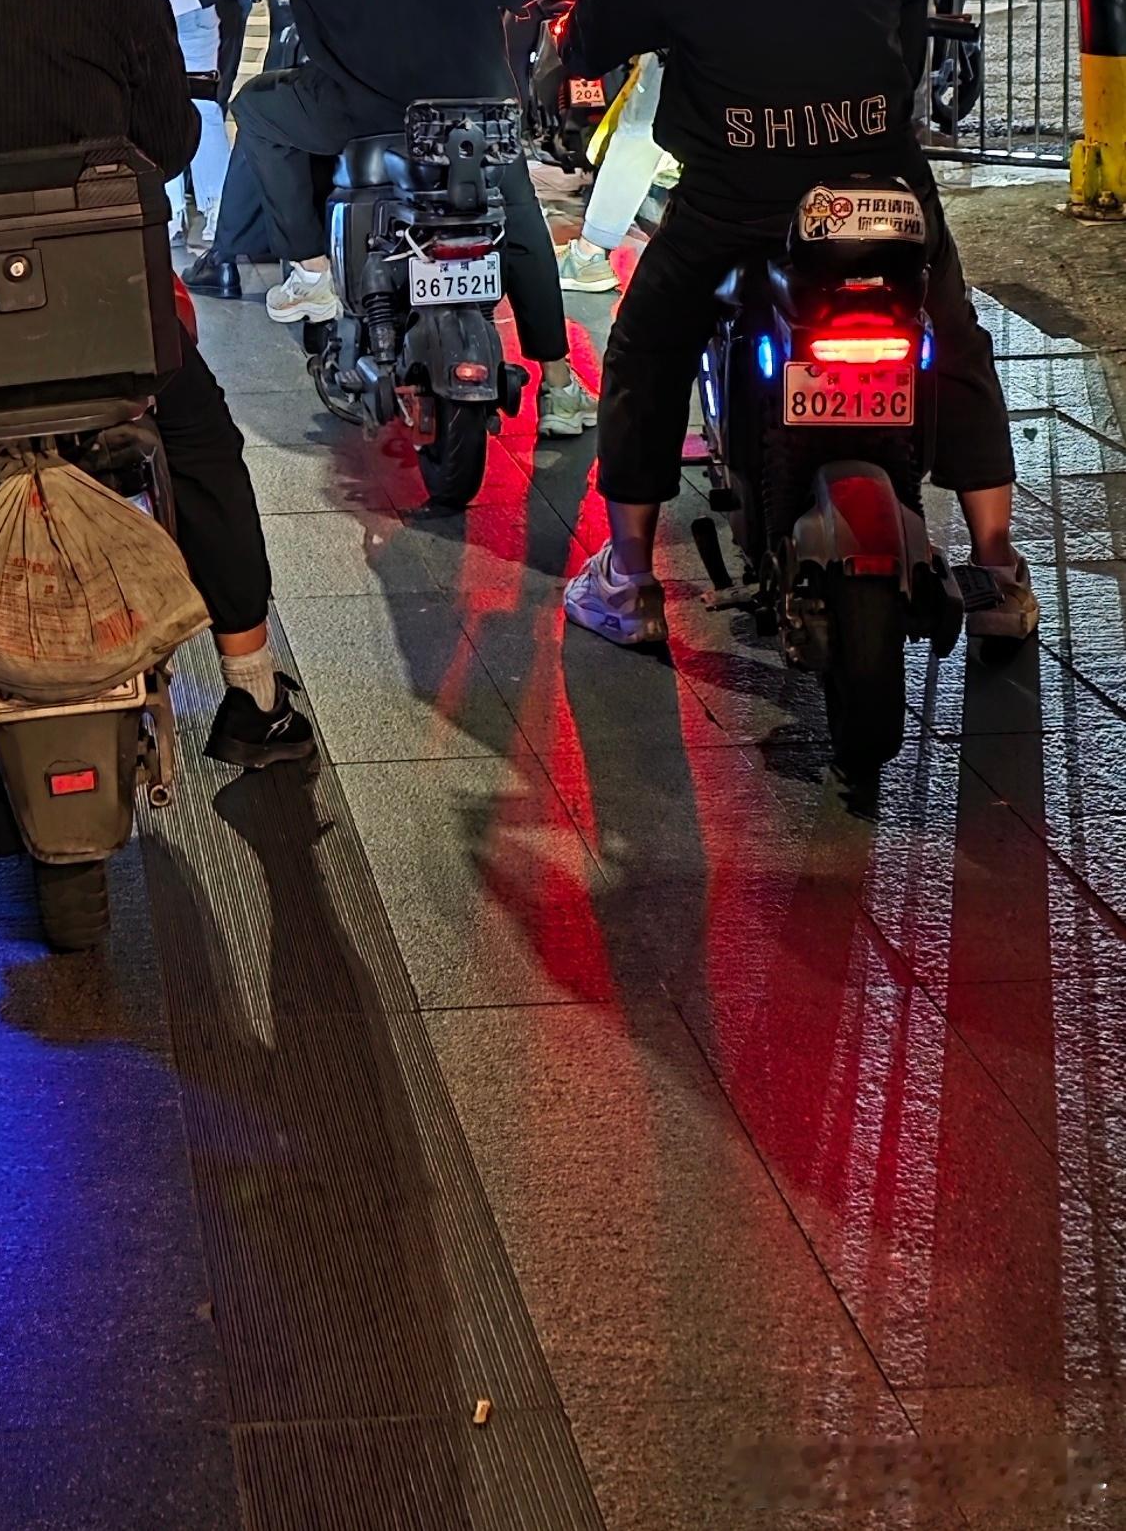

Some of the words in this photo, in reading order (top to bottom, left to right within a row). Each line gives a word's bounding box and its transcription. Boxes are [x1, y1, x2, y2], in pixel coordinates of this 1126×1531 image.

[575, 89, 601, 101] 204
[725, 94, 887, 149] SHING
[415, 274, 496, 299] 36752H
[791, 391, 907, 418] 80213C
